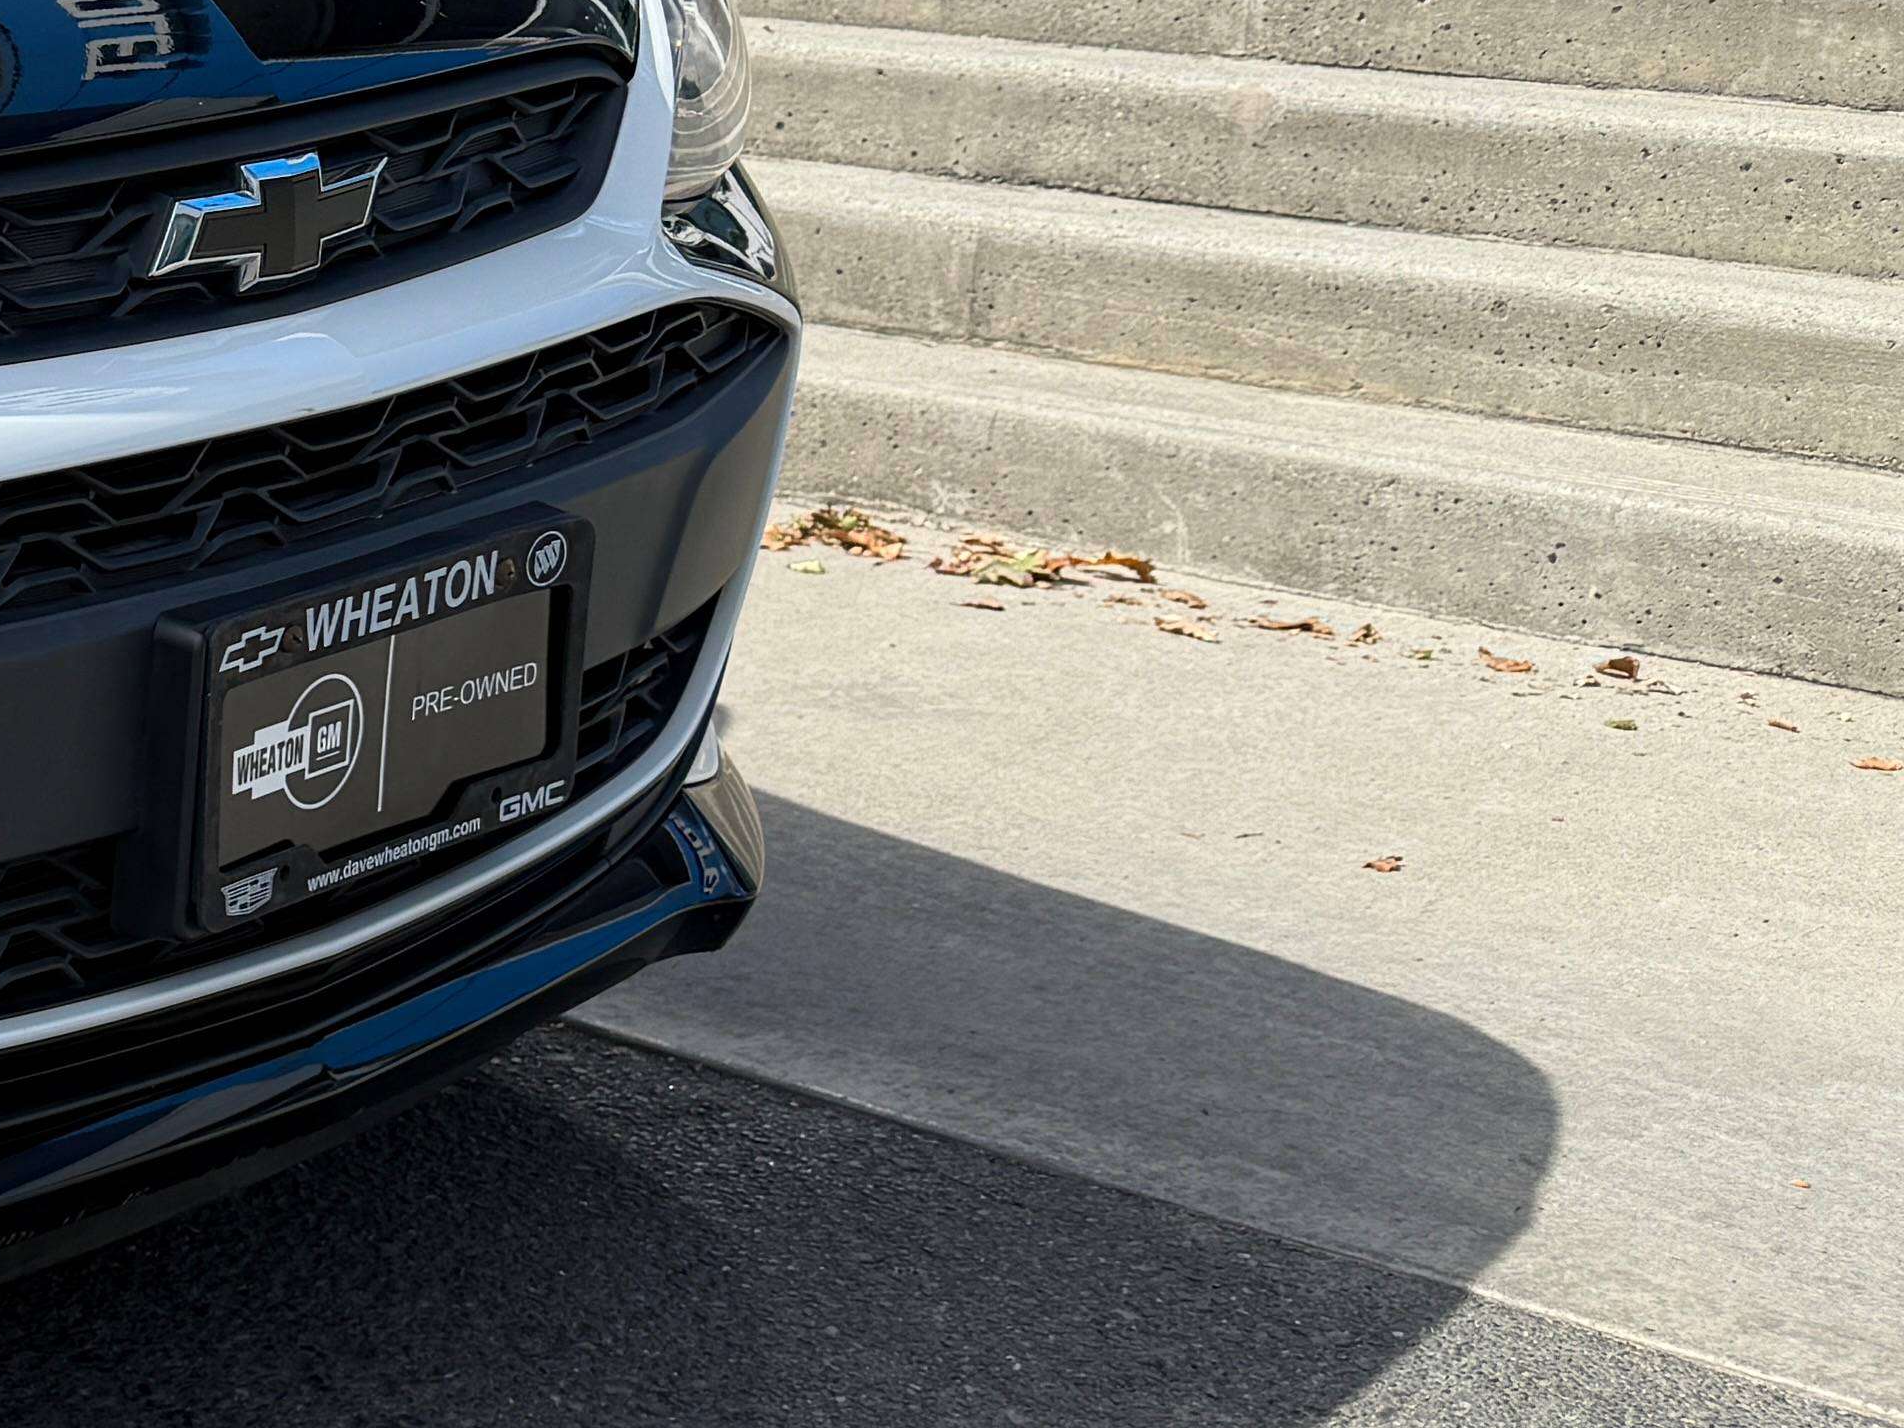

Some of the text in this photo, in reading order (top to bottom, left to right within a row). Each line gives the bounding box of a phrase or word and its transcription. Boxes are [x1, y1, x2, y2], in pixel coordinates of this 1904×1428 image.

[306, 550, 498, 652] WHEATON
[411, 662, 538, 721] PRE-OWNED
[237, 733, 304, 786] WHEATON
[316, 720, 342, 755] GM
[499, 780, 565, 822] GMC
[307, 816, 482, 893] www.davewheatongm.com
